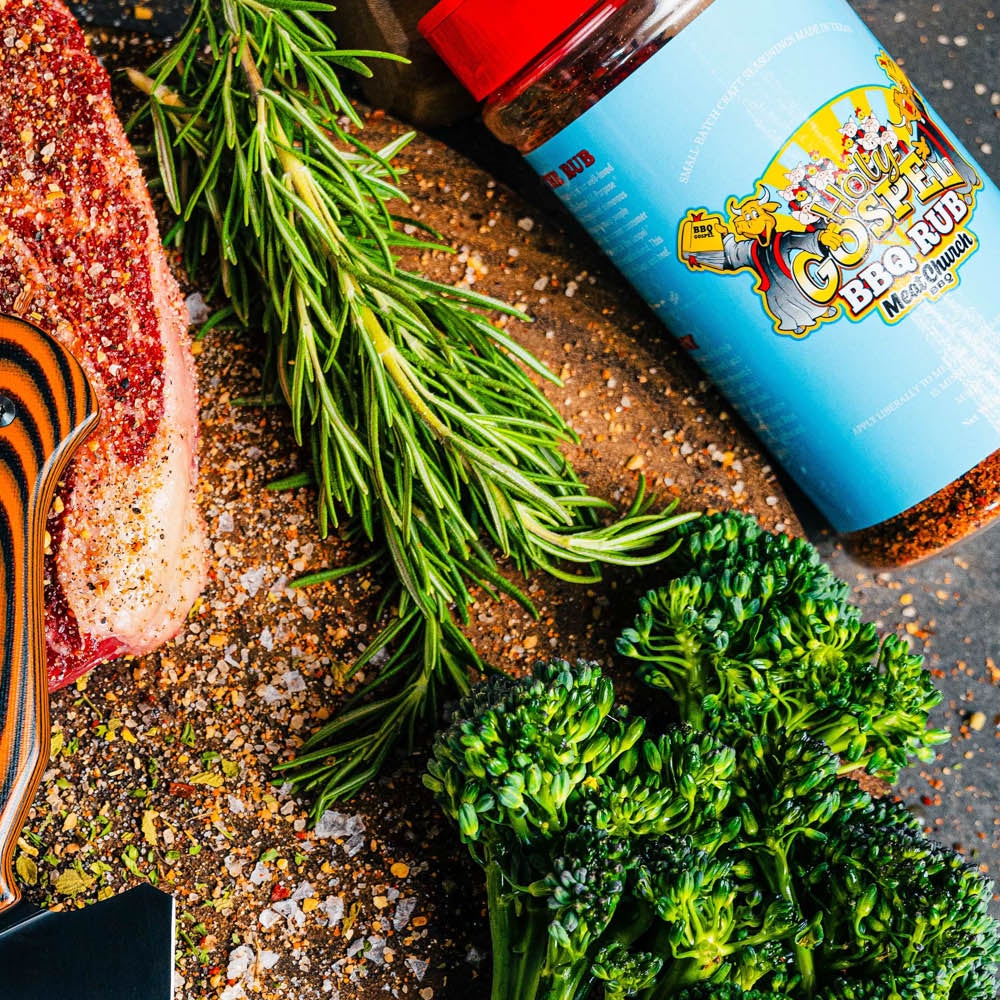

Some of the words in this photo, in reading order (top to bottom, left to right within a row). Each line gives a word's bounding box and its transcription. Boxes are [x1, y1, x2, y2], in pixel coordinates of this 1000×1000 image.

[558, 149, 596, 180] RUB
[680, 147, 699, 184] SMALL
[694, 109, 721, 145] BATCH
[717, 77, 745, 110] CRAFT
[811, 142, 901, 223] Holy
[693, 224, 713, 235] BBQ
[790, 153, 967, 305] GOSPEL
[839, 244, 919, 314] BBQ
[906, 190, 969, 256] RUB
[881, 279, 928, 319] Meat
[921, 231, 974, 290] Church
[929, 272, 955, 296] BBQ
[877, 383, 921, 422] LIBERALLY
